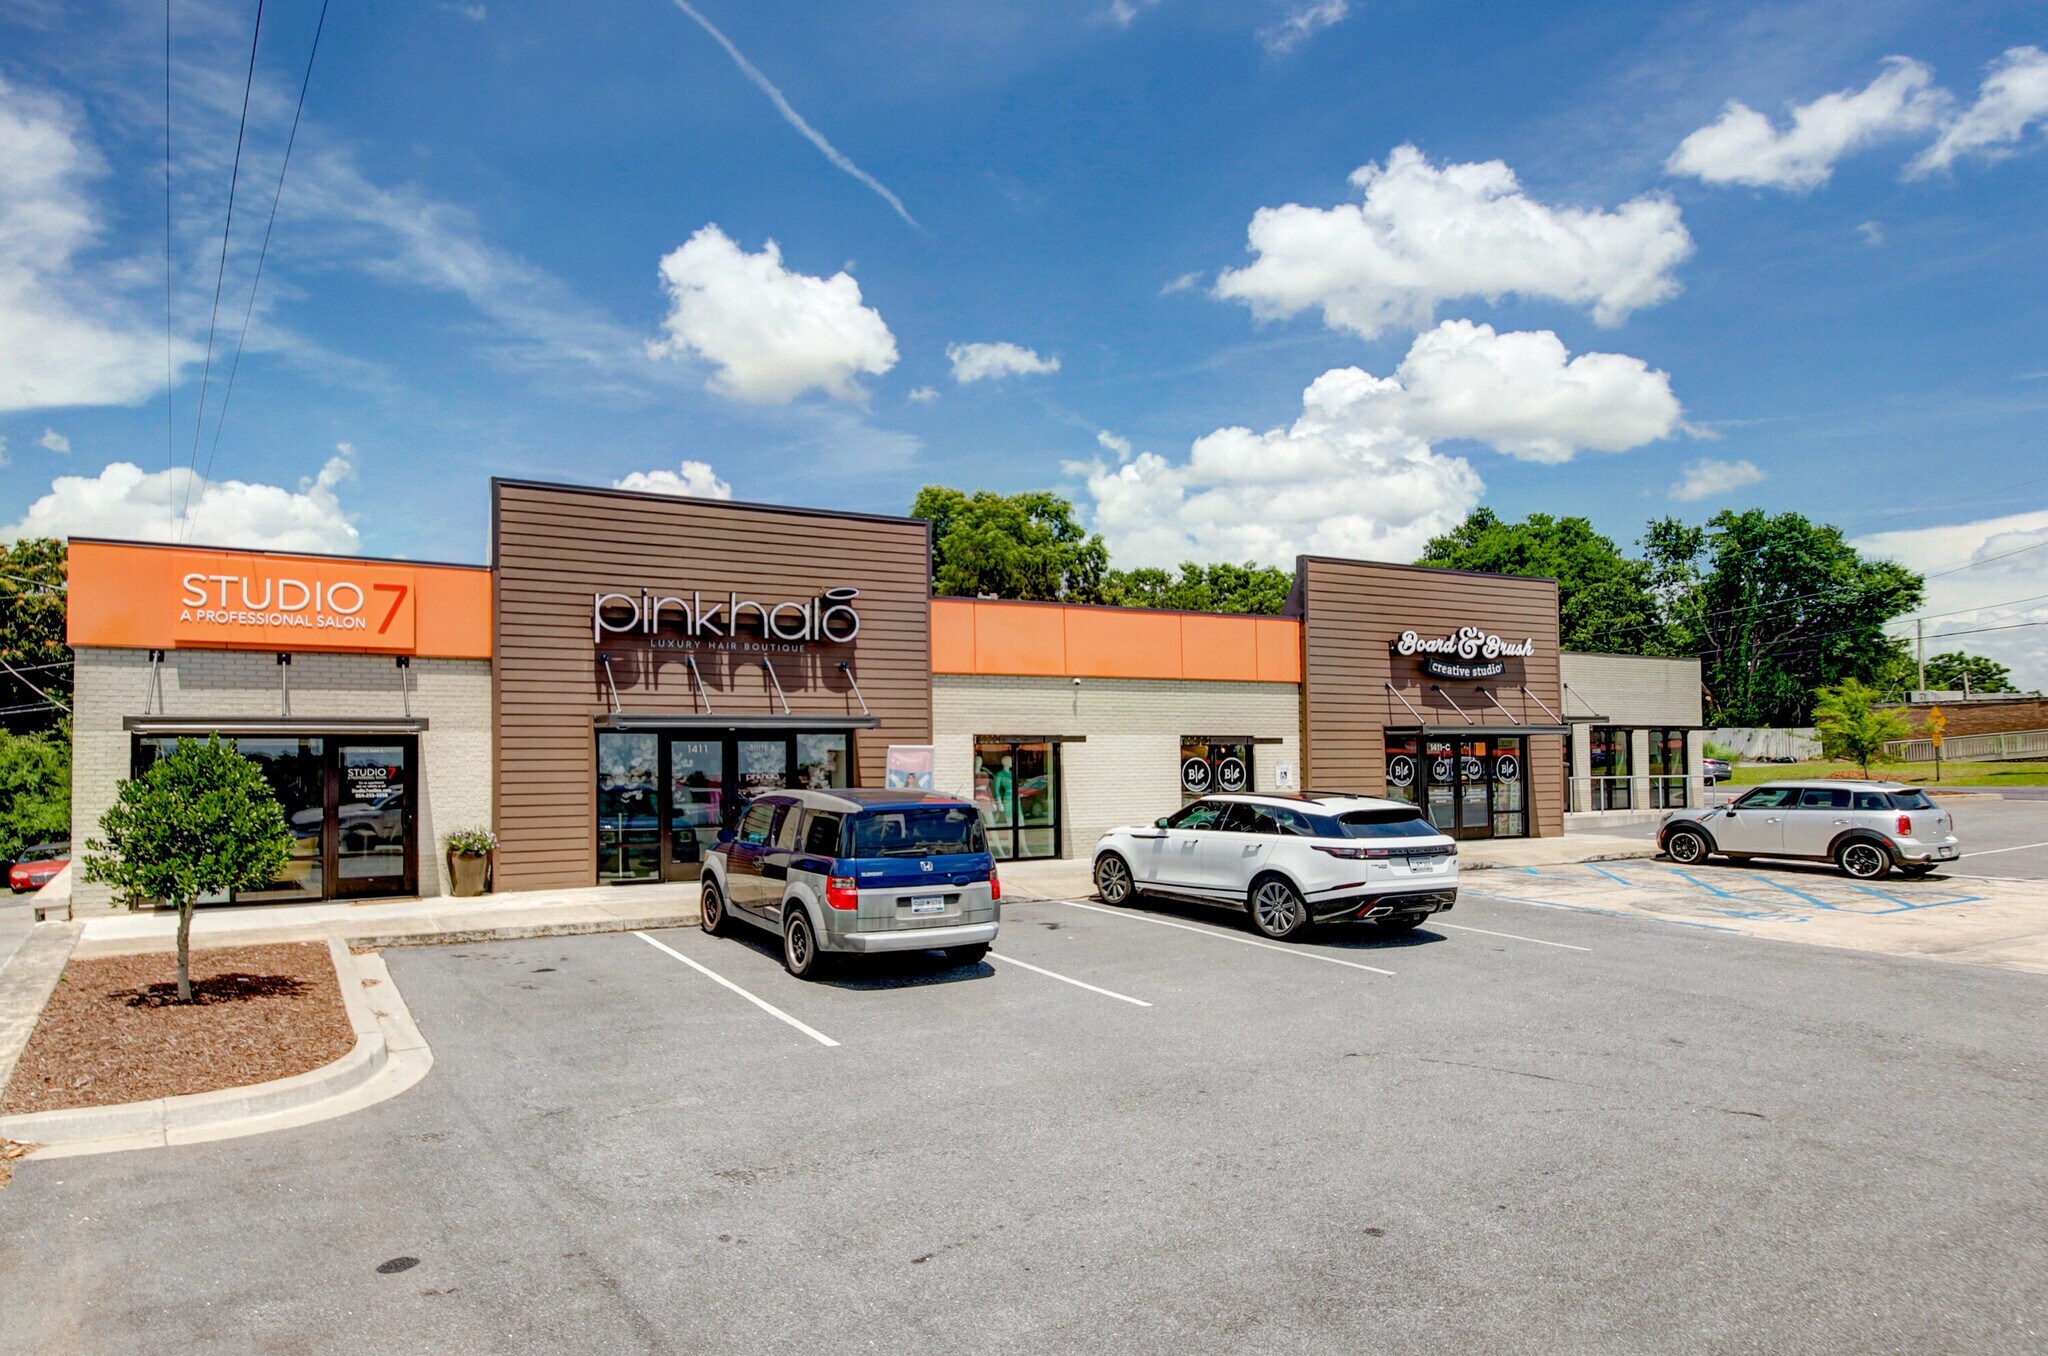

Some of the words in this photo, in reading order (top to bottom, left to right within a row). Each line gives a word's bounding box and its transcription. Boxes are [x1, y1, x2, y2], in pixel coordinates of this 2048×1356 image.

[182, 573, 364, 614] STUDIO
[373, 583, 408, 634] 7
[180, 609, 192, 623] A
[196, 609, 313, 628] PROFESSIONAL
[317, 615, 366, 630] SALON
[650, 639, 701, 650] LUXURY
[708, 641, 737, 651] HAIR
[743, 642, 805, 654] BOUTIQUE
[1397, 630, 1457, 656] Board
[1458, 626, 1486, 660] &
[1481, 634, 1535, 659] Brush
[1432, 662, 1470, 677] creative
[1472, 664, 1501, 677] studio
[687, 744, 708, 754] 1411
[1429, 743, 1451, 753] 1411-C
[347, 768, 387, 777] STUDIO
[387, 767, 396, 780] 7
